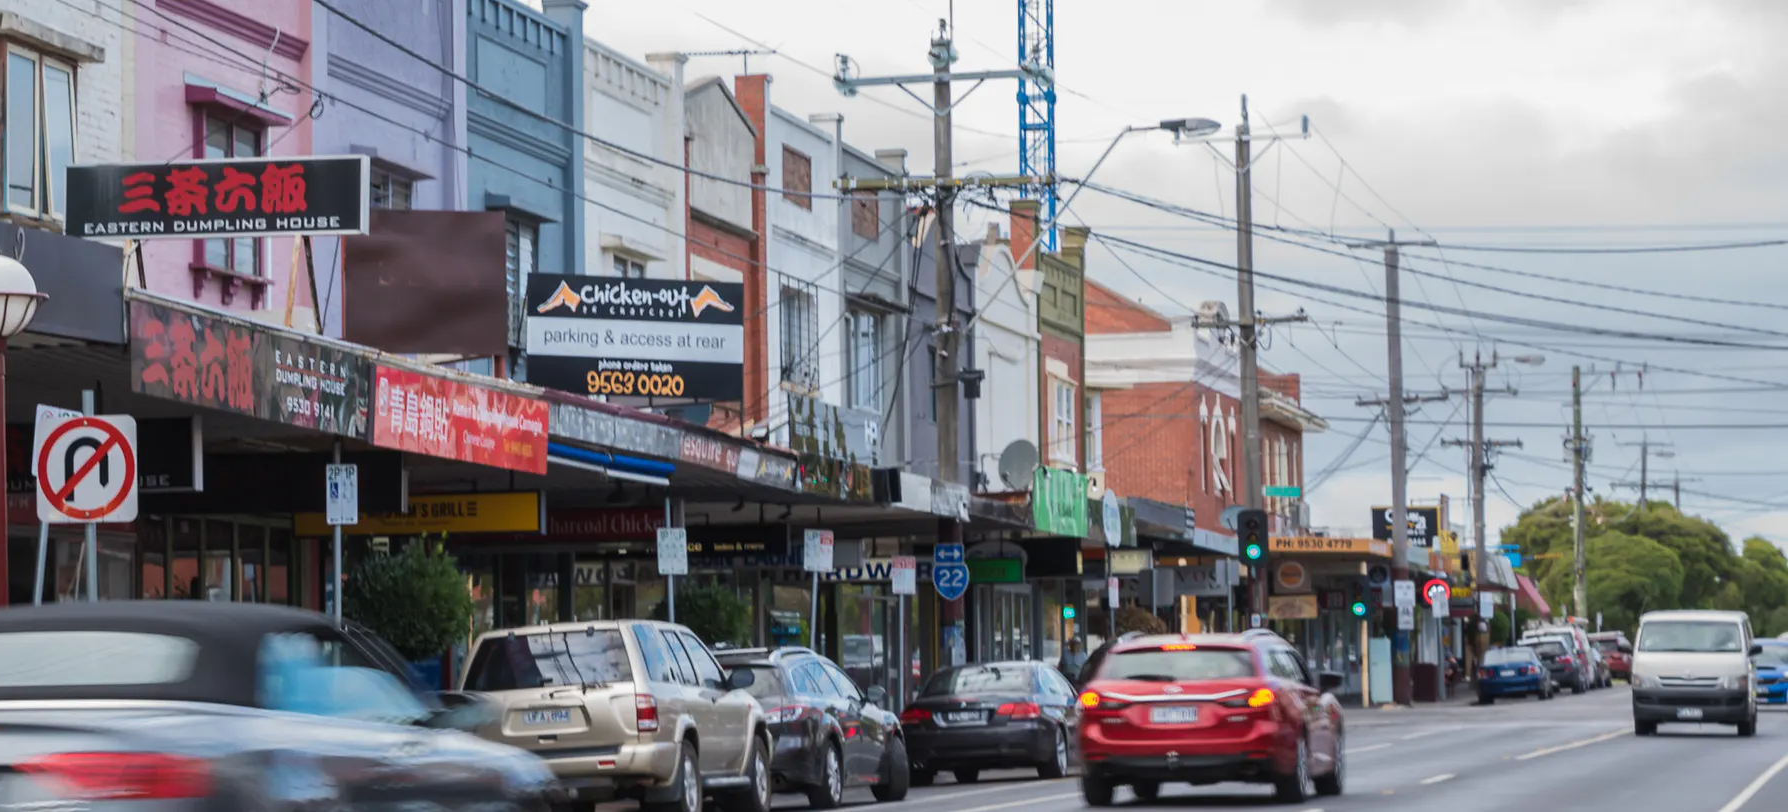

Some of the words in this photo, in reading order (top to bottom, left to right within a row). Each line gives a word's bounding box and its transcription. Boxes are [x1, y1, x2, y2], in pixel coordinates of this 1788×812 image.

[84, 220, 165, 235] EASTERN
[174, 218, 267, 233] DUMPLING
[276, 216, 340, 230] HOUSE
[580, 281, 691, 315] Chicken-out
[543, 328, 599, 347] parking
[604, 330, 614, 344] &
[620, 333, 672, 347] access
[677, 334, 691, 348] at
[696, 337, 726, 349] rear
[275, 349, 347, 379] EASTERN
[275, 368, 318, 391] DUMPLING
[319, 379, 346, 397] HOUSE
[587, 370, 635, 395] 9563
[637, 373, 685, 396] 0020
[286, 396, 311, 414] 9530
[314, 402, 335, 419] 9141
[550, 515, 608, 536] harcoal
[611, 512, 665, 534] Chicke
[938, 568, 964, 588] 22
